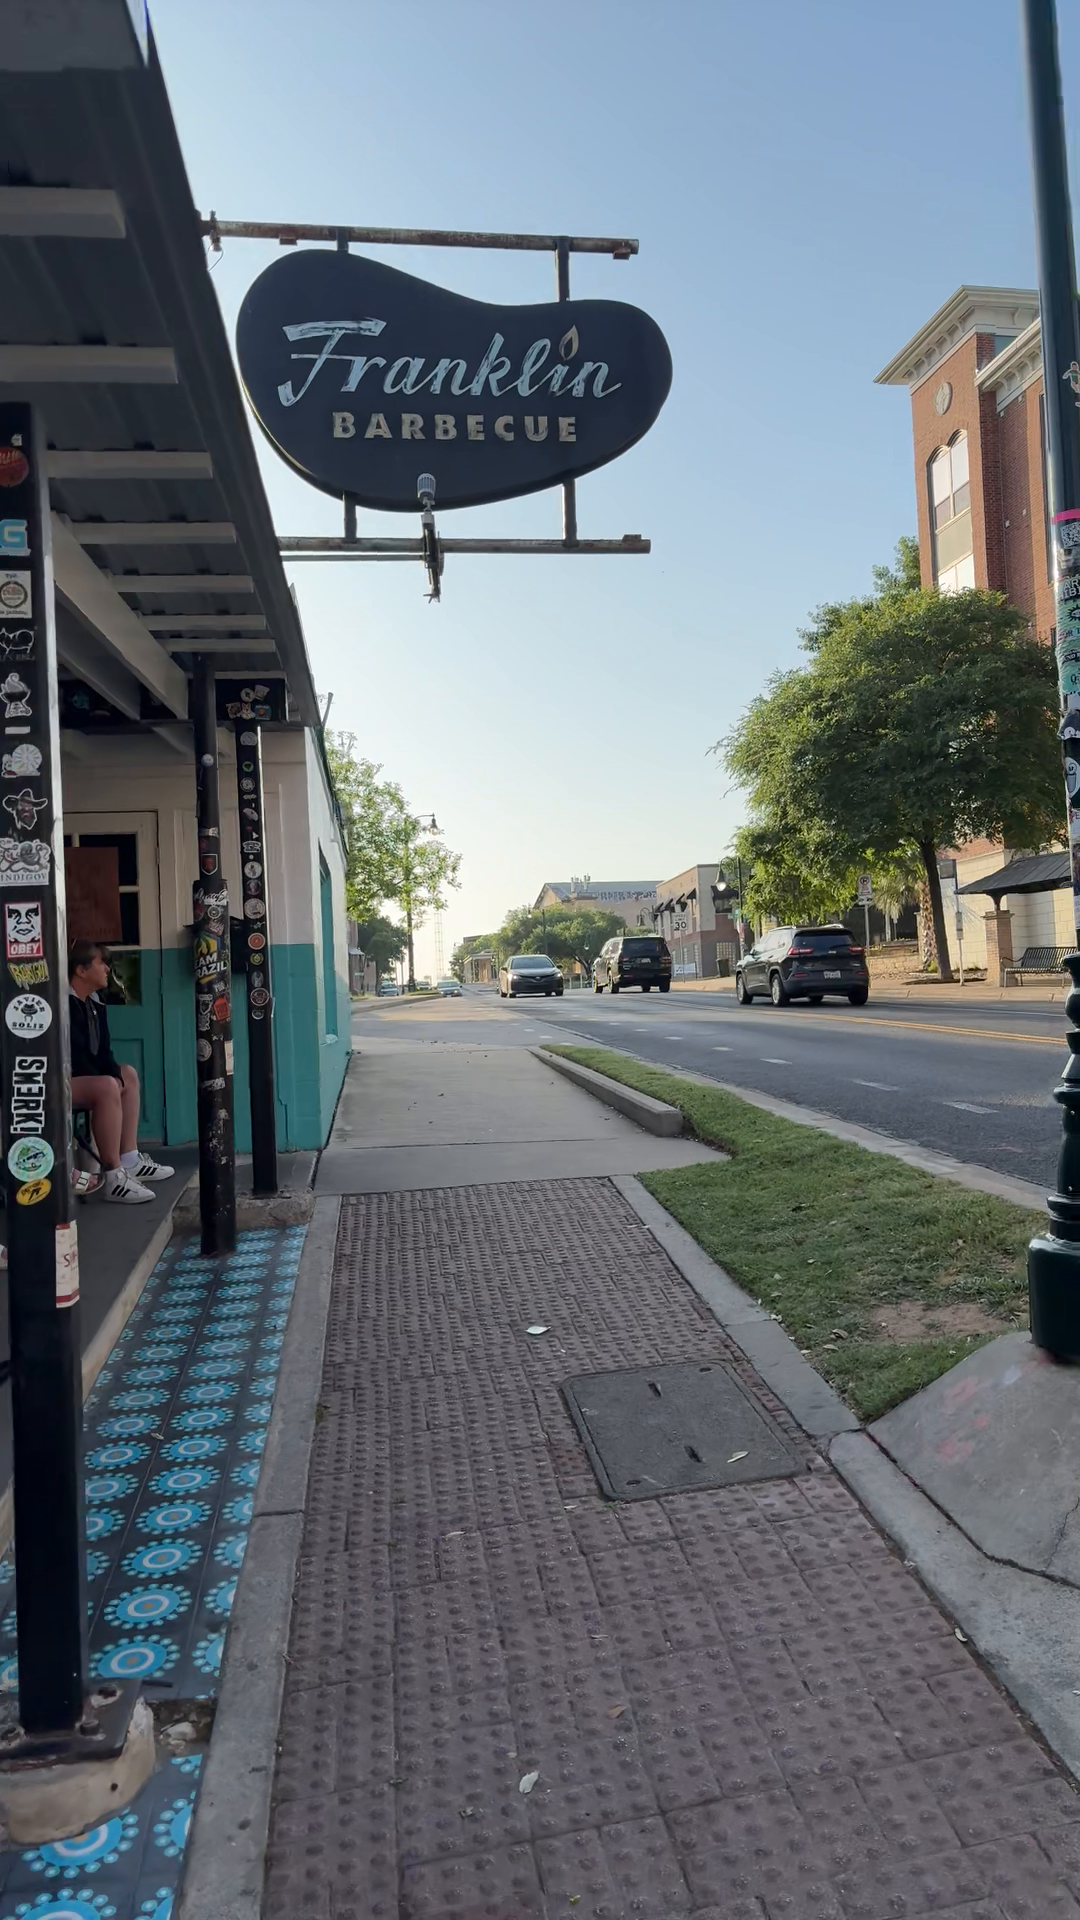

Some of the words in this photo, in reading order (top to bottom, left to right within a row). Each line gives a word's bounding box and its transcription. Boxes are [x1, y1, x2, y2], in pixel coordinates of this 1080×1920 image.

[278, 316, 622, 407] Franklin
[332, 411, 577, 442] BARBECUE
[674, 921, 687, 929] 30
[10, 944, 40, 955] OBEY
[194, 952, 218, 969] EAM
[195, 960, 228, 978] RAZIL
[13, 996, 46, 1013] JAVIER
[12, 1021, 45, 1030] SOLIZ
